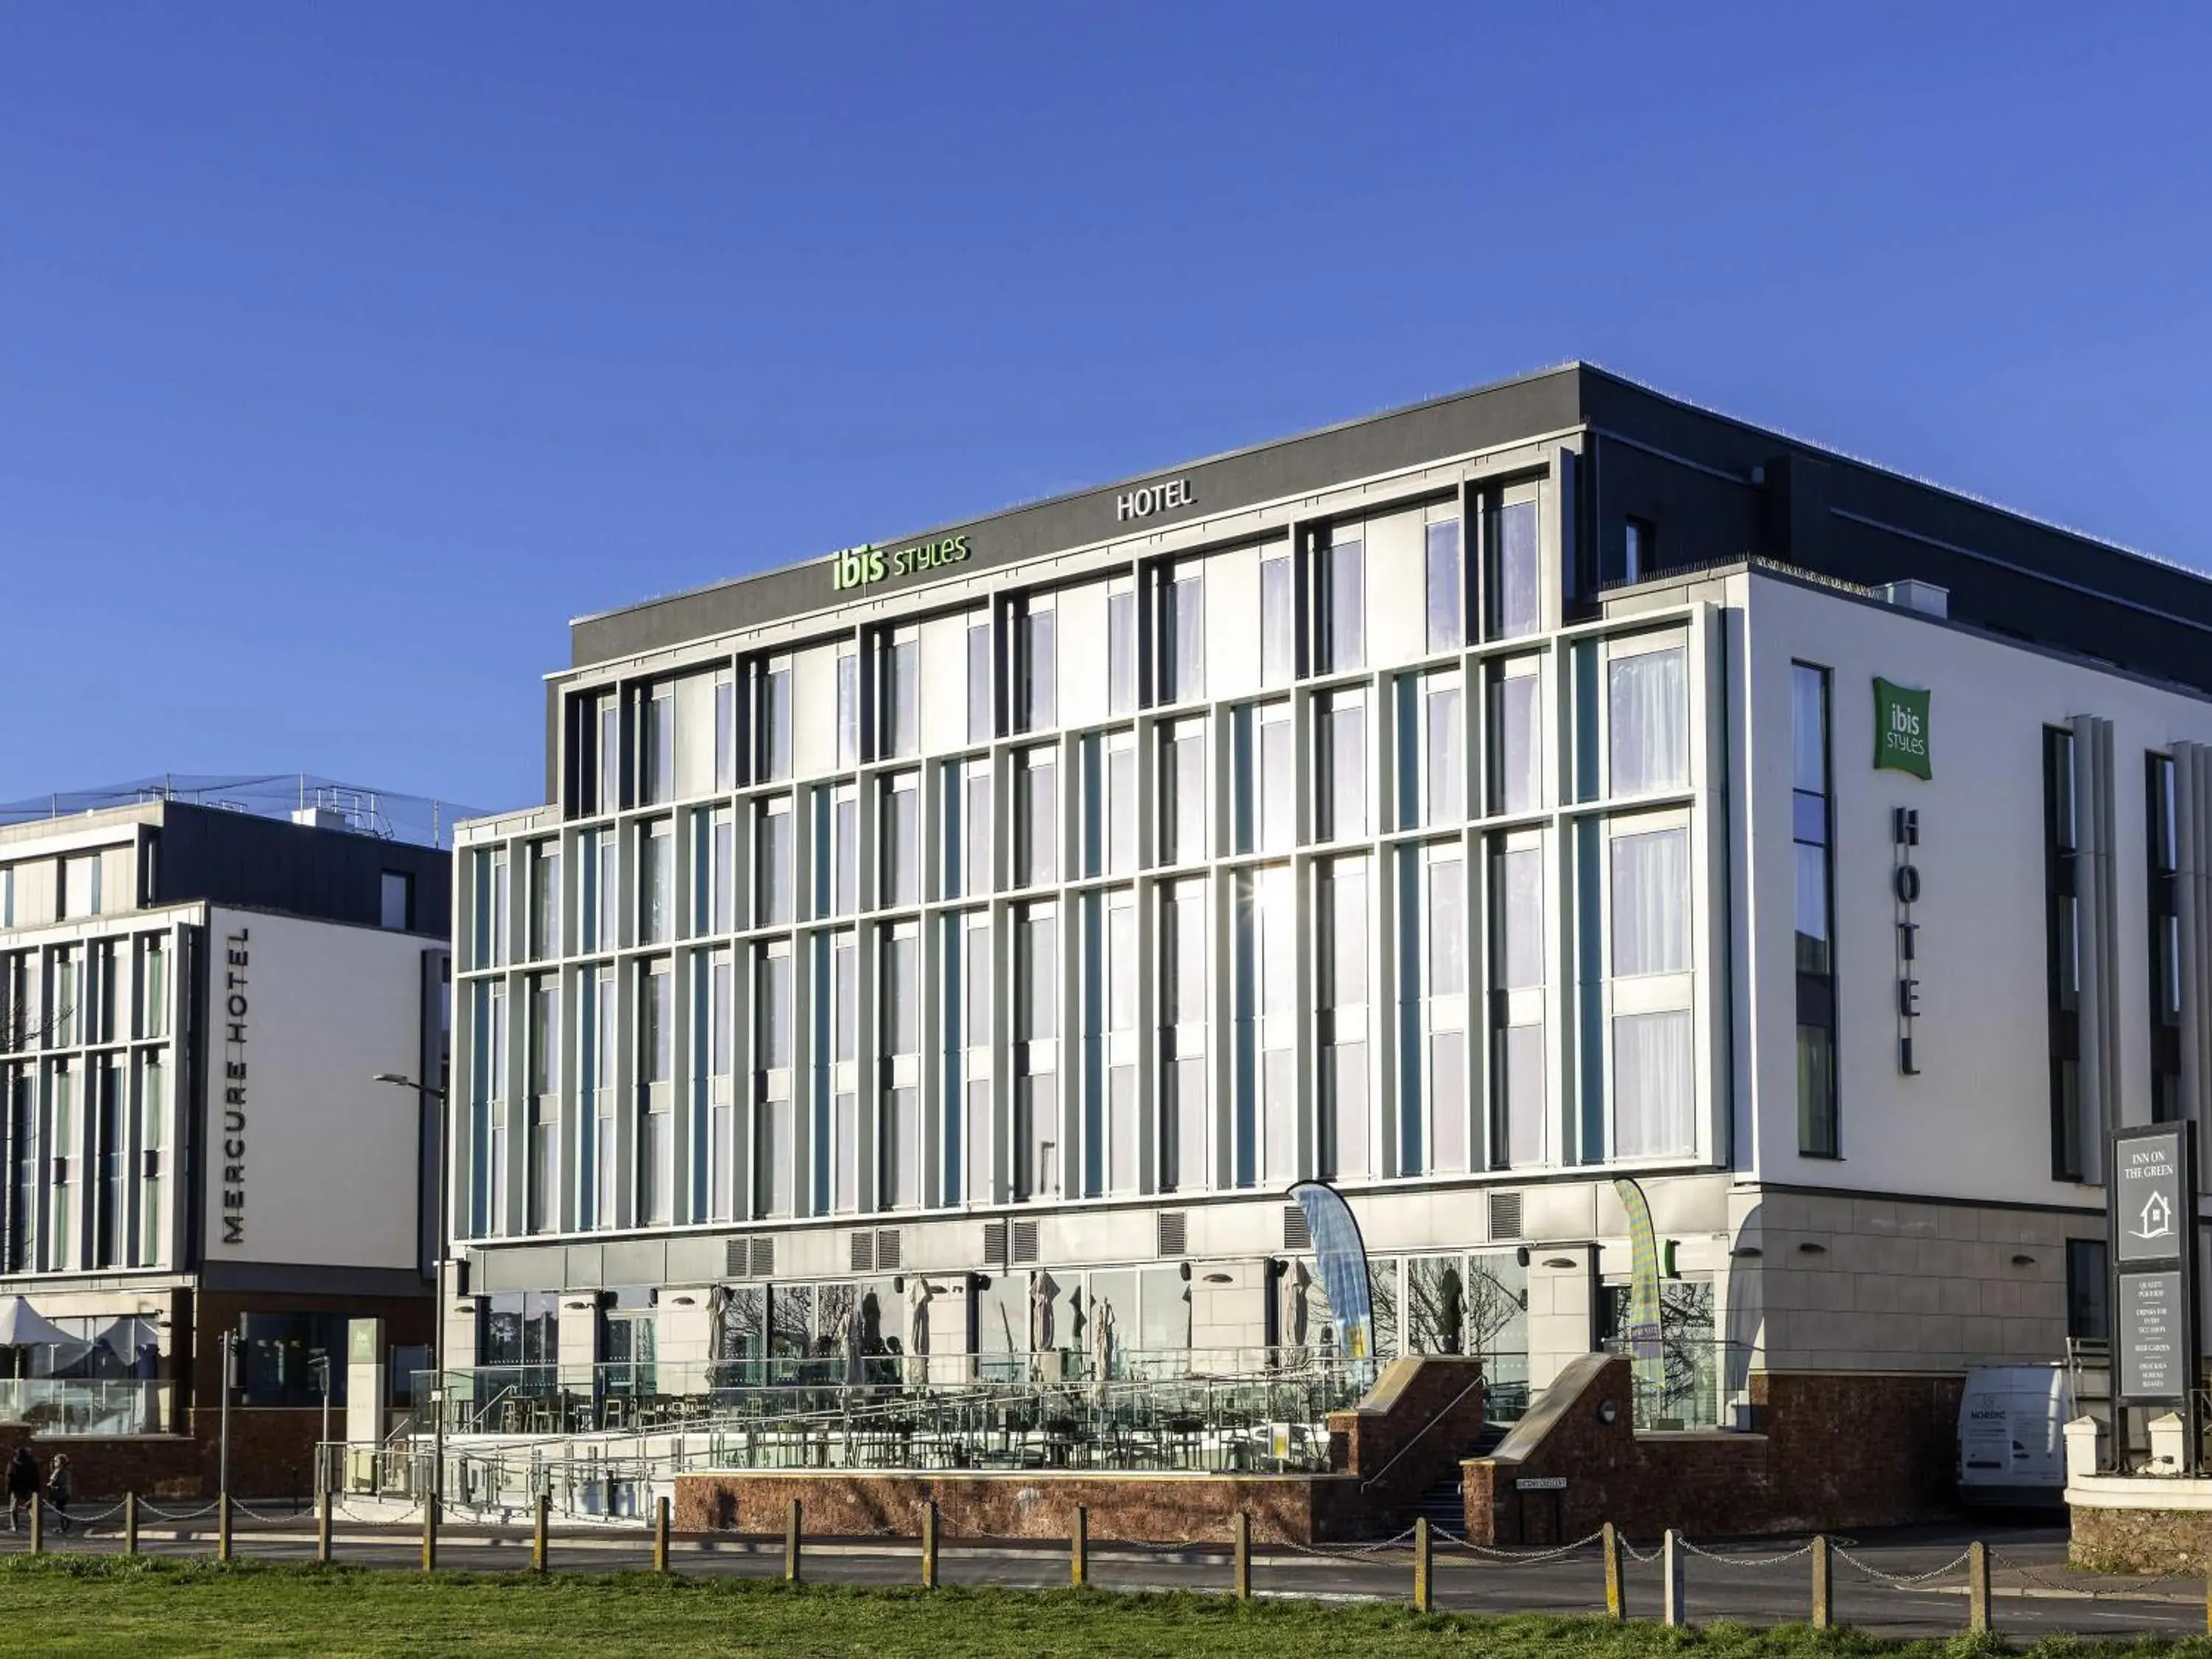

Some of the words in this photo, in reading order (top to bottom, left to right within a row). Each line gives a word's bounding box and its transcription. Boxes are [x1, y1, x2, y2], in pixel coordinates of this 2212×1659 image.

[1117, 479, 1192, 521] HOTEL
[833, 544, 886, 591] ibis
[1891, 702, 1920, 736] ibis
[1892, 807, 1921, 1075] HOTEL
[226, 927, 249, 1043] HOTEL
[222, 1061, 248, 1245] MERCURE
[2124, 1166, 2143, 1180] THE
[2143, 1162, 2174, 1178] GREEN
[2132, 1151, 2149, 1164] INN
[2150, 1149, 2166, 1163] ON
